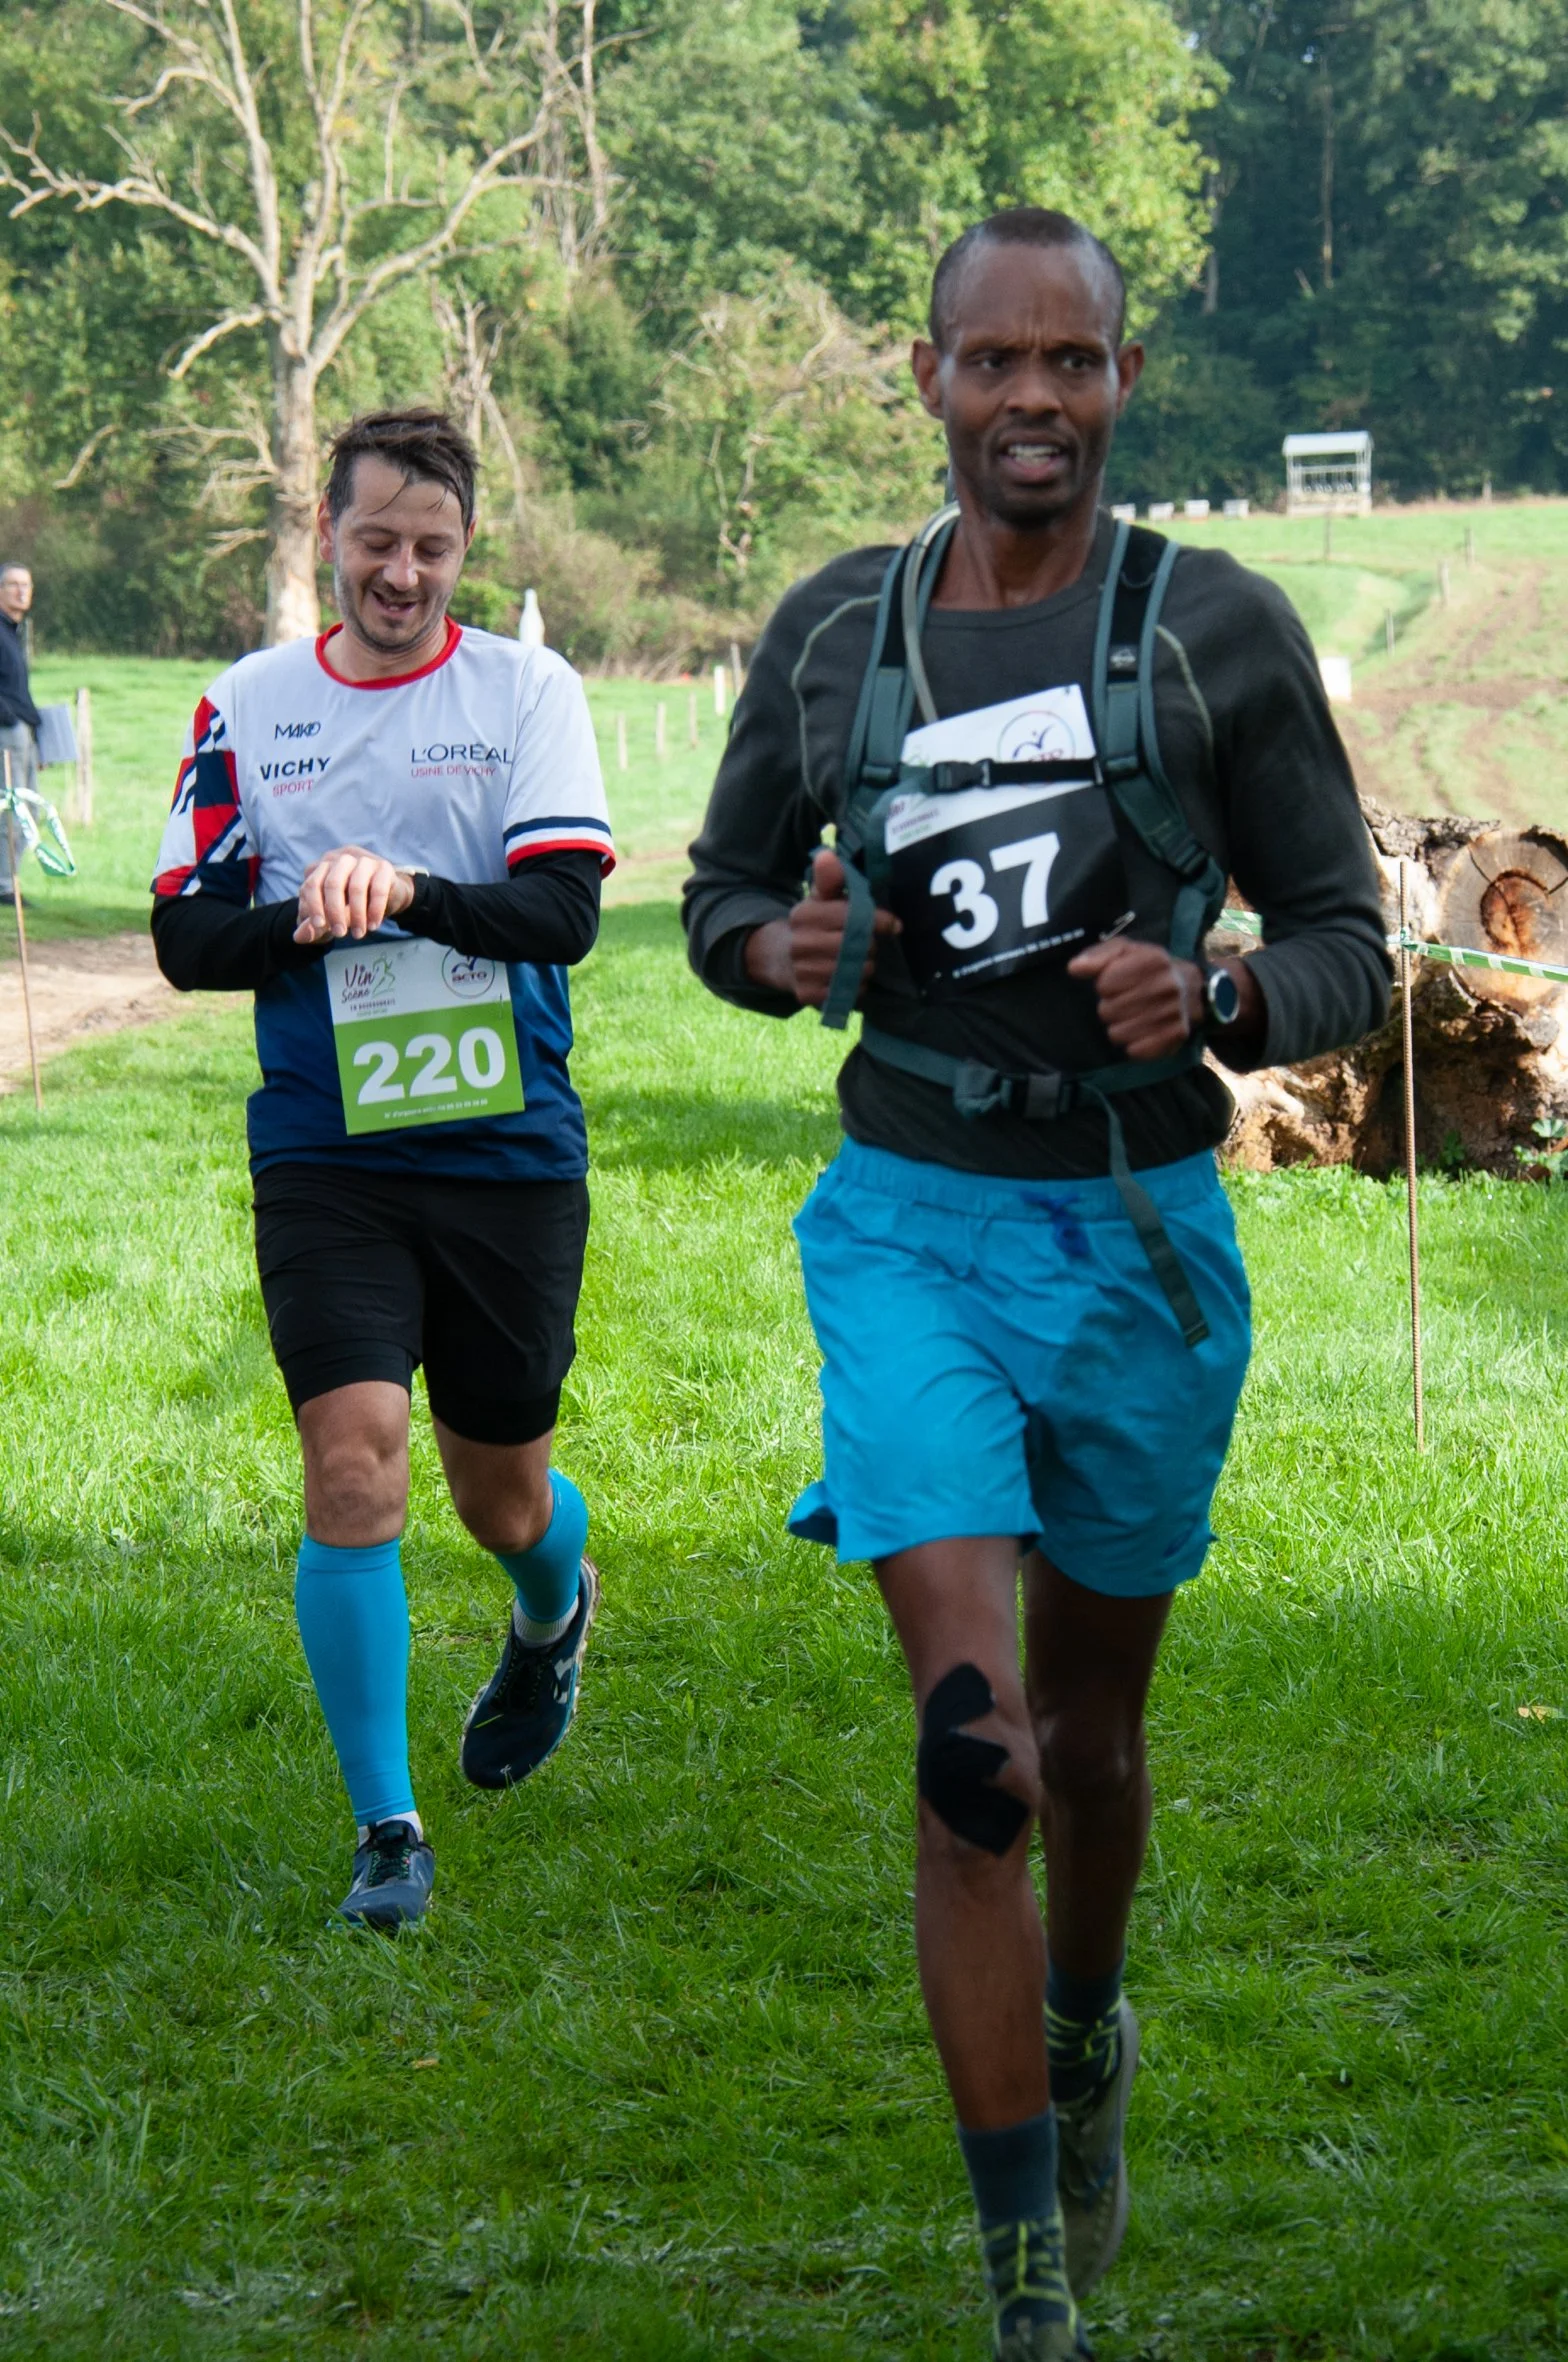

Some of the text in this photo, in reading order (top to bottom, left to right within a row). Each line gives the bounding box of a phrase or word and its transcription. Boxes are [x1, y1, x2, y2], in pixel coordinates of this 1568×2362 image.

[260, 757, 331, 780] VICHY
[411, 765, 496, 778] USINE DE VICHY
[273, 779, 314, 797] SPORT
[930, 832, 1061, 949] 37
[353, 1026, 506, 1105] 220
